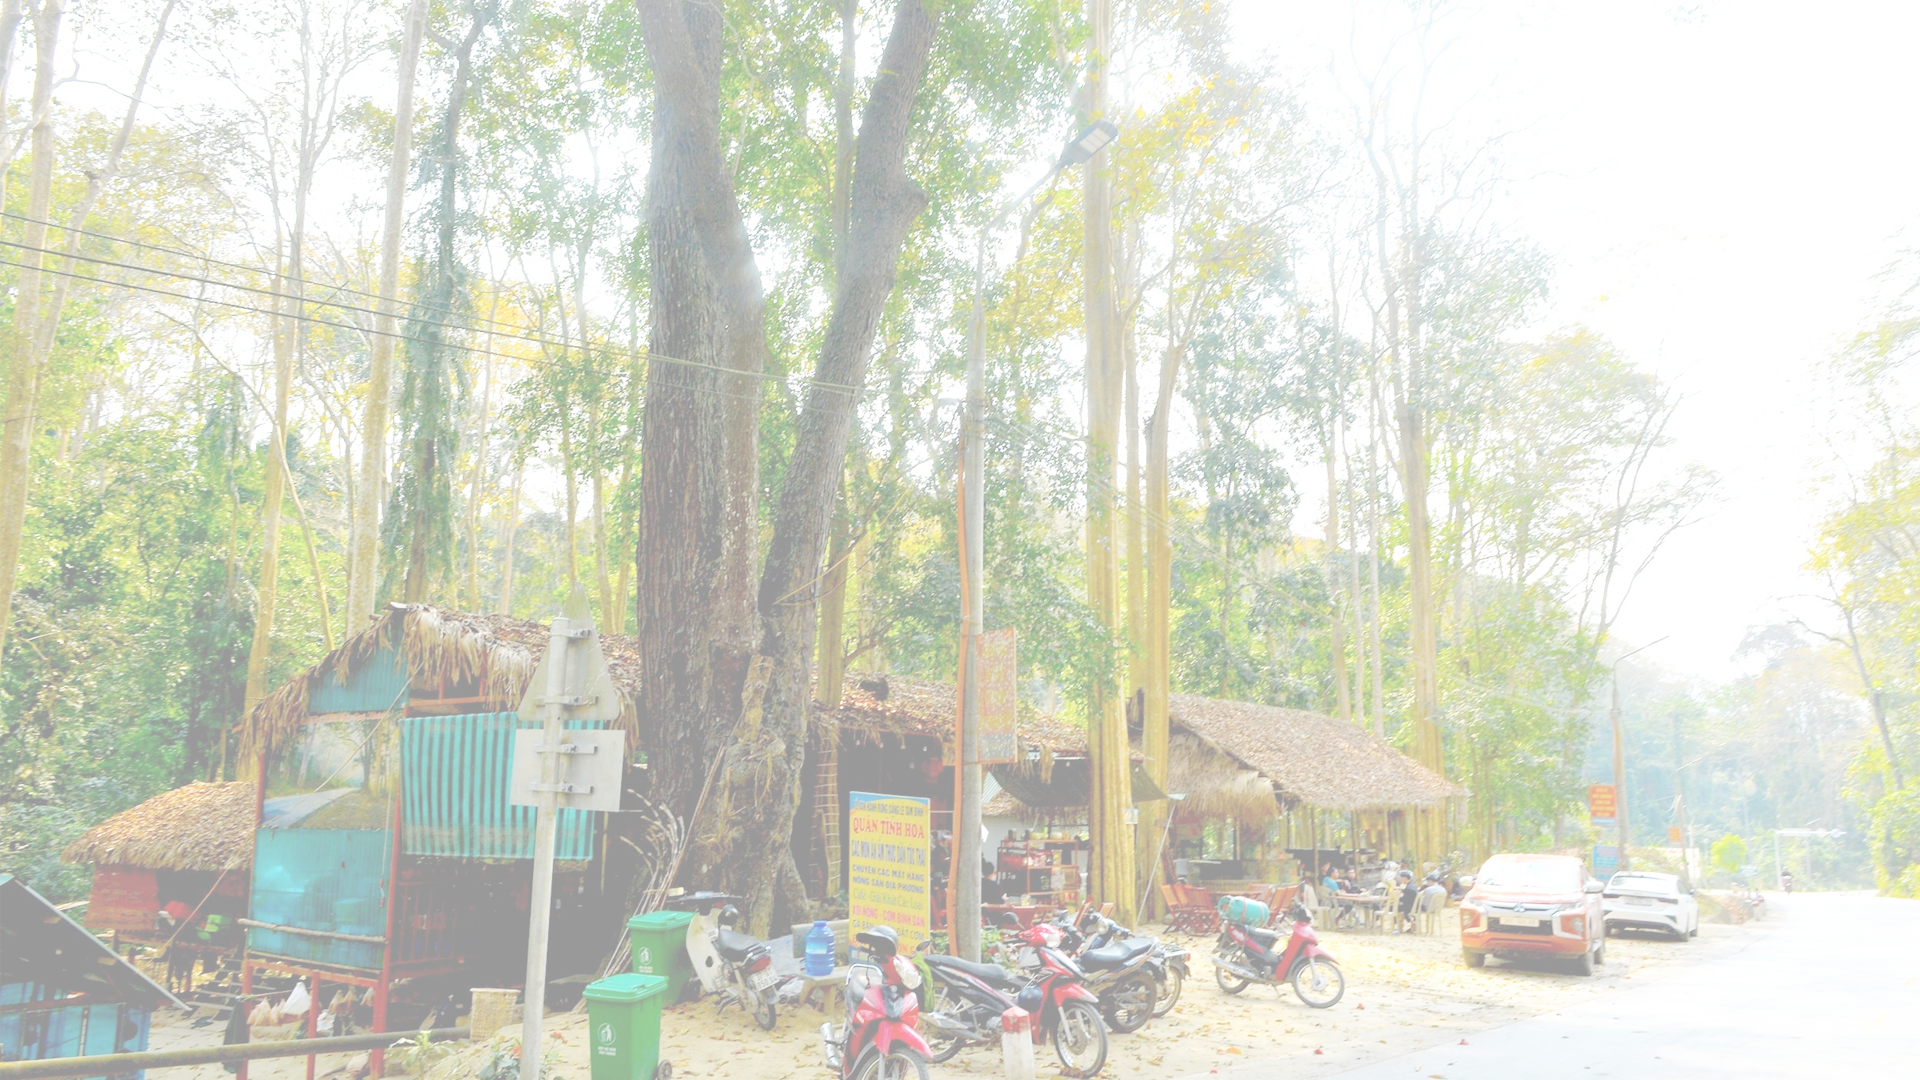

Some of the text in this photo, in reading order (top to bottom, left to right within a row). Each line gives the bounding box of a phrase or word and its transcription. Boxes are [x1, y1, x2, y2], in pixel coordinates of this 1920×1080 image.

[853, 815, 878, 834] QUÁN
[905, 823, 924, 839] HOA
[853, 863, 876, 875] CHUYÊN
[877, 866, 890, 877] CÁC
[853, 875, 870, 886] NÔNG
